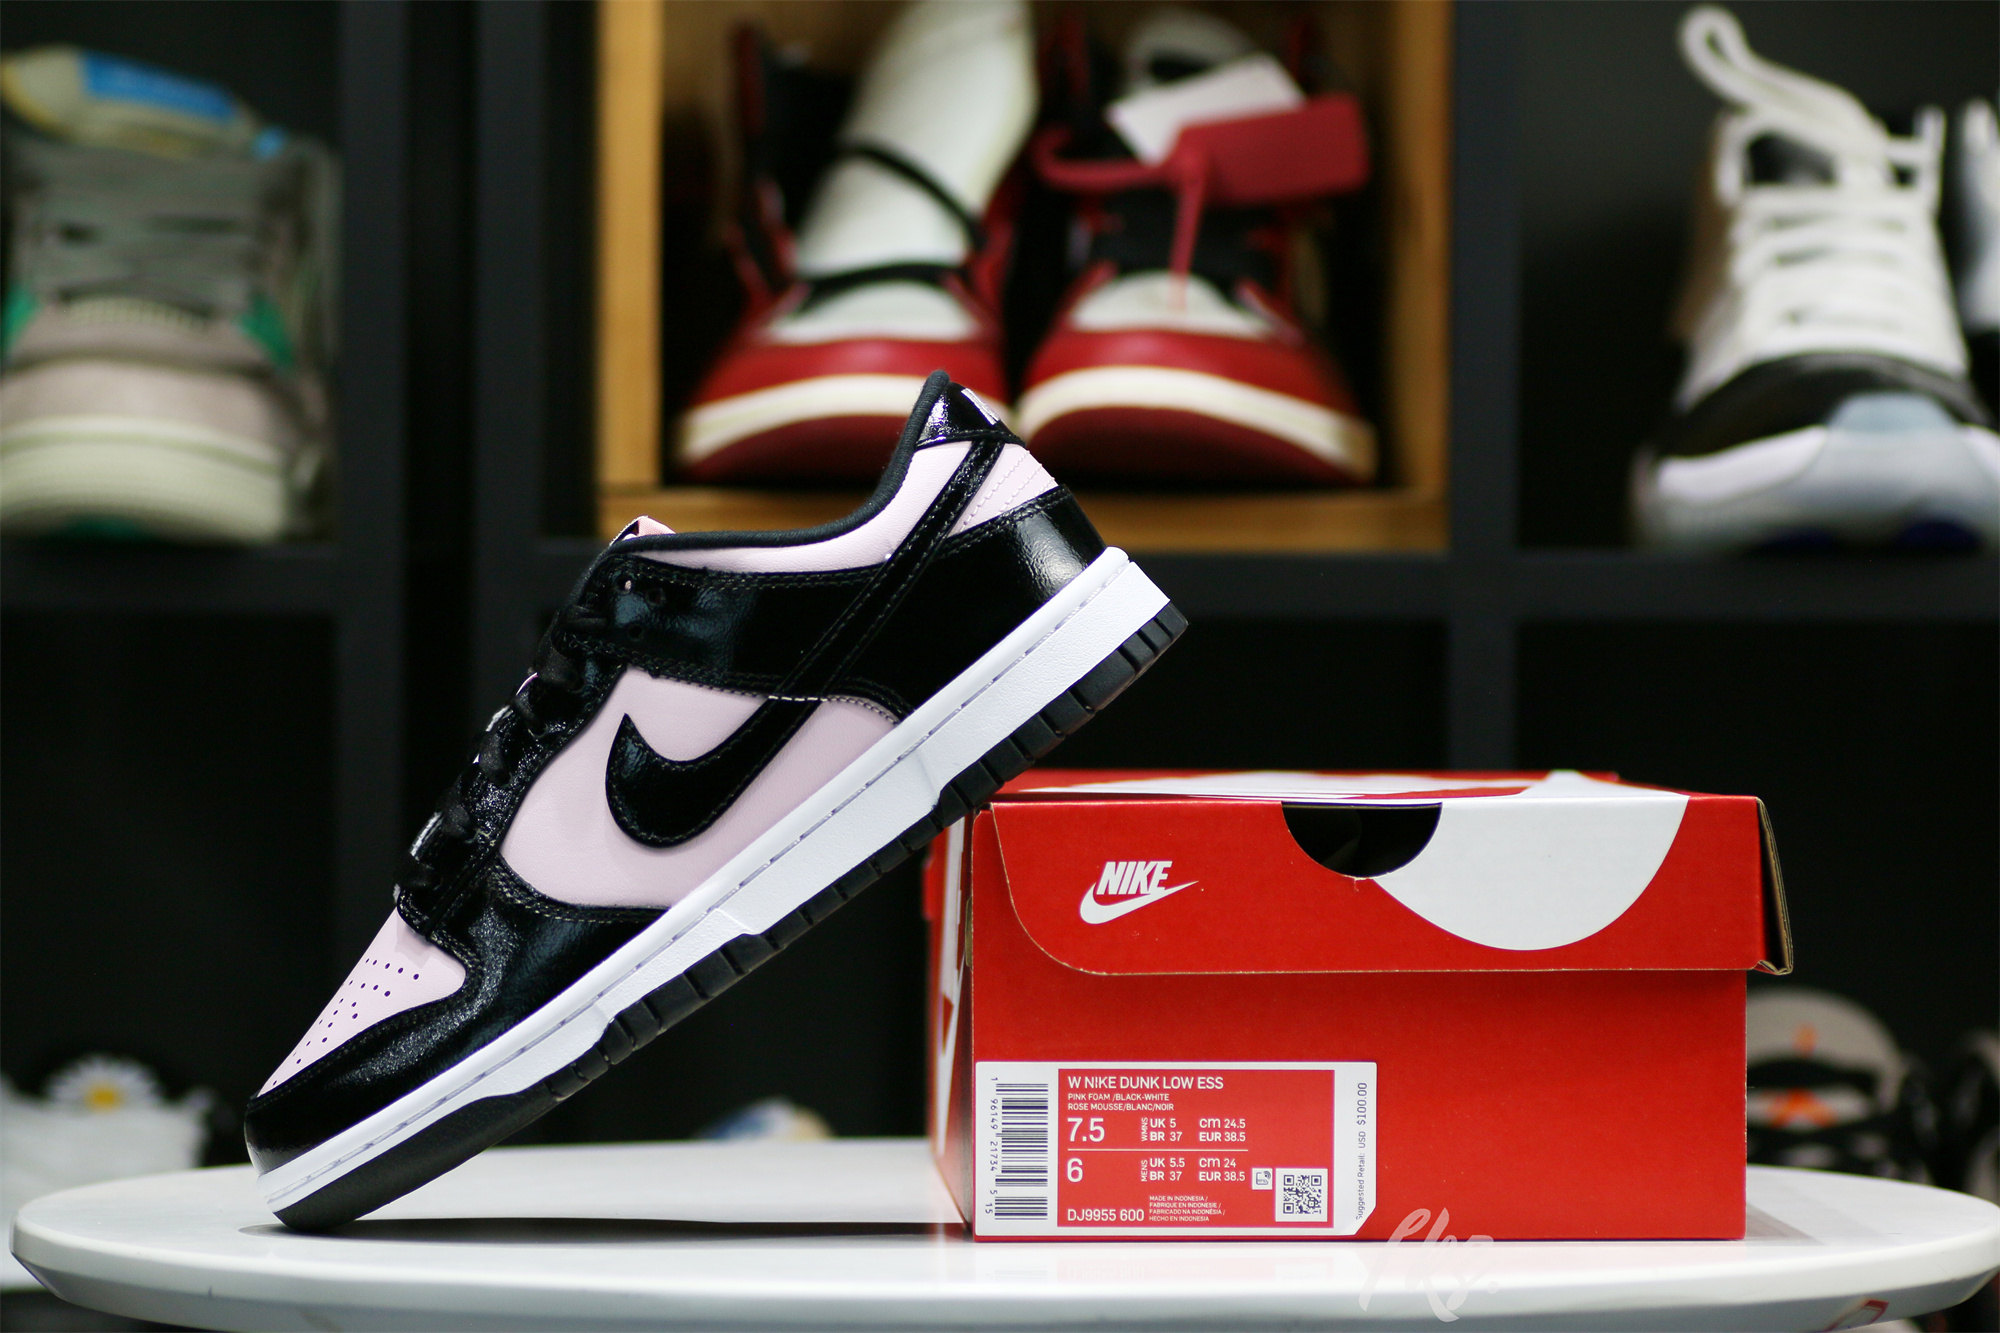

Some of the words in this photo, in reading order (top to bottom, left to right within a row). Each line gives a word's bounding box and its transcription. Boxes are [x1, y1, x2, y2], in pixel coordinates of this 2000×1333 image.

[1096, 861, 1172, 895] NIKE
[1068, 1076, 1081, 1089] W
[1084, 1076, 1116, 1089] NIKE
[1120, 1076, 1160, 1089] DUNK
[1163, 1076, 1194, 1089] LOW
[1197, 1076, 1224, 1089] ESS
[1068, 1093, 1086, 1101] PINK
[1088, 1093, 1110, 1101] FOAM
[1112, 1093, 1169, 1102] /BLACK-WHITE
[1356, 1082, 1368, 1125] $100.00
[990, 1099, 998, 1130] 96149
[1068, 1103, 1088, 1111] ROSE
[1090, 1103, 1174, 1112] MOUSSE/BLANC/NOIR
[1067, 1117, 1105, 1142] 7.5
[1150, 1118, 1166, 1129] UK
[1169, 1118, 1176, 1129] 5
[1199, 1118, 1221, 1129] cm
[1224, 1118, 1246, 1129] 24.5
[1150, 1131, 1165, 1142] BR
[1169, 1131, 1182, 1142] 37
[1199, 1131, 1221, 1142] EUR
[1224, 1131, 1246, 1142] 38.5
[1358, 1131, 1366, 1148] USD
[990, 1141, 998, 1172] 21734
[1150, 1158, 1165, 1168] UK
[1169, 1158, 1185, 1168] 5.5
[1199, 1158, 1220, 1168] cm
[1224, 1158, 1237, 1168] 24
[1067, 1158, 1083, 1182] 6
[1357, 1152, 1365, 1178] Retail:
[1150, 1171, 1164, 1181] BR
[1169, 1171, 1182, 1181] 37
[1199, 1171, 1221, 1181] EUR
[1224, 1171, 1246, 1181] 38.5
[1355, 1179, 1365, 1220] Suggested
[985, 1203, 993, 1214] 15
[1067, 1209, 1117, 1222] DJ9955
[1120, 1209, 1145, 1222] 600
